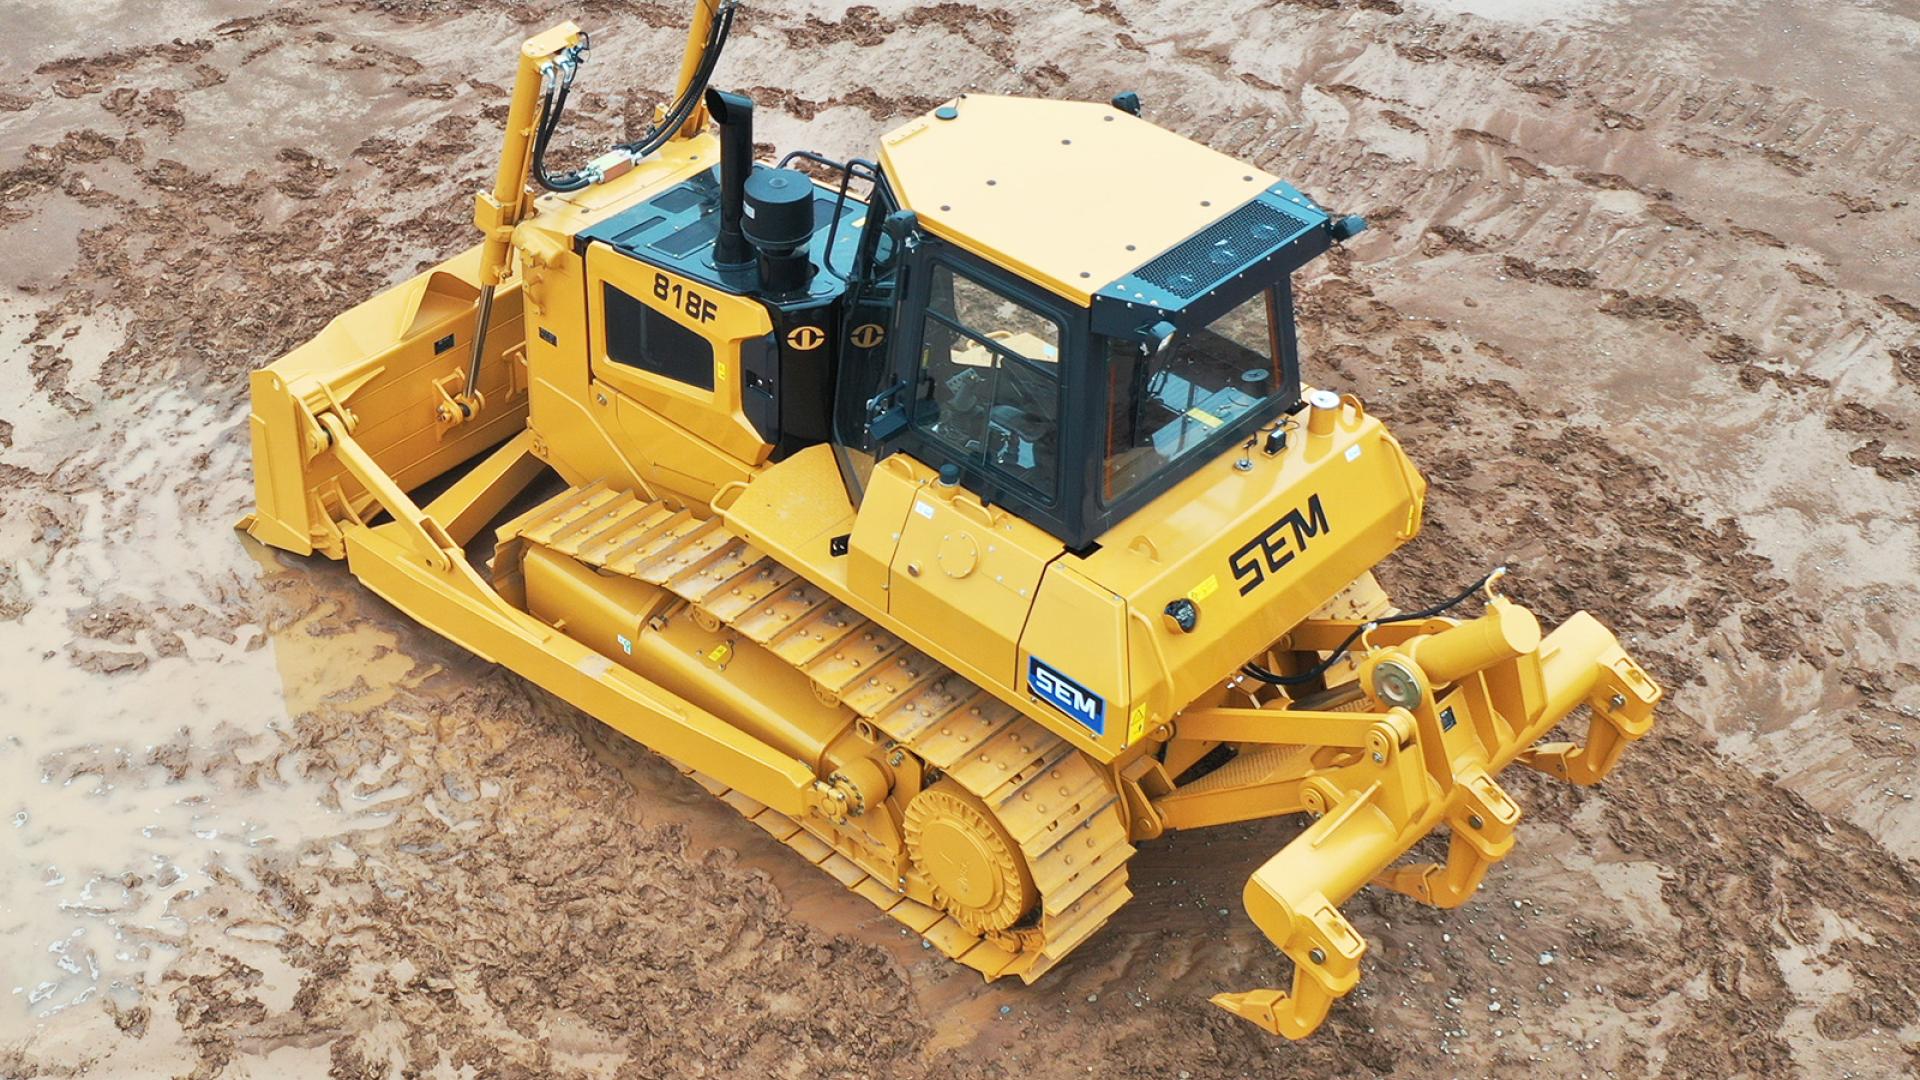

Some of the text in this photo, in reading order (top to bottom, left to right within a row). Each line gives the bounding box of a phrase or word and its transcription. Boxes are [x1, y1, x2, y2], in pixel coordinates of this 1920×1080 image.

[653, 273, 718, 324] 818F
[1229, 493, 1330, 597] SEM
[1035, 665, 1096, 720] SEM
